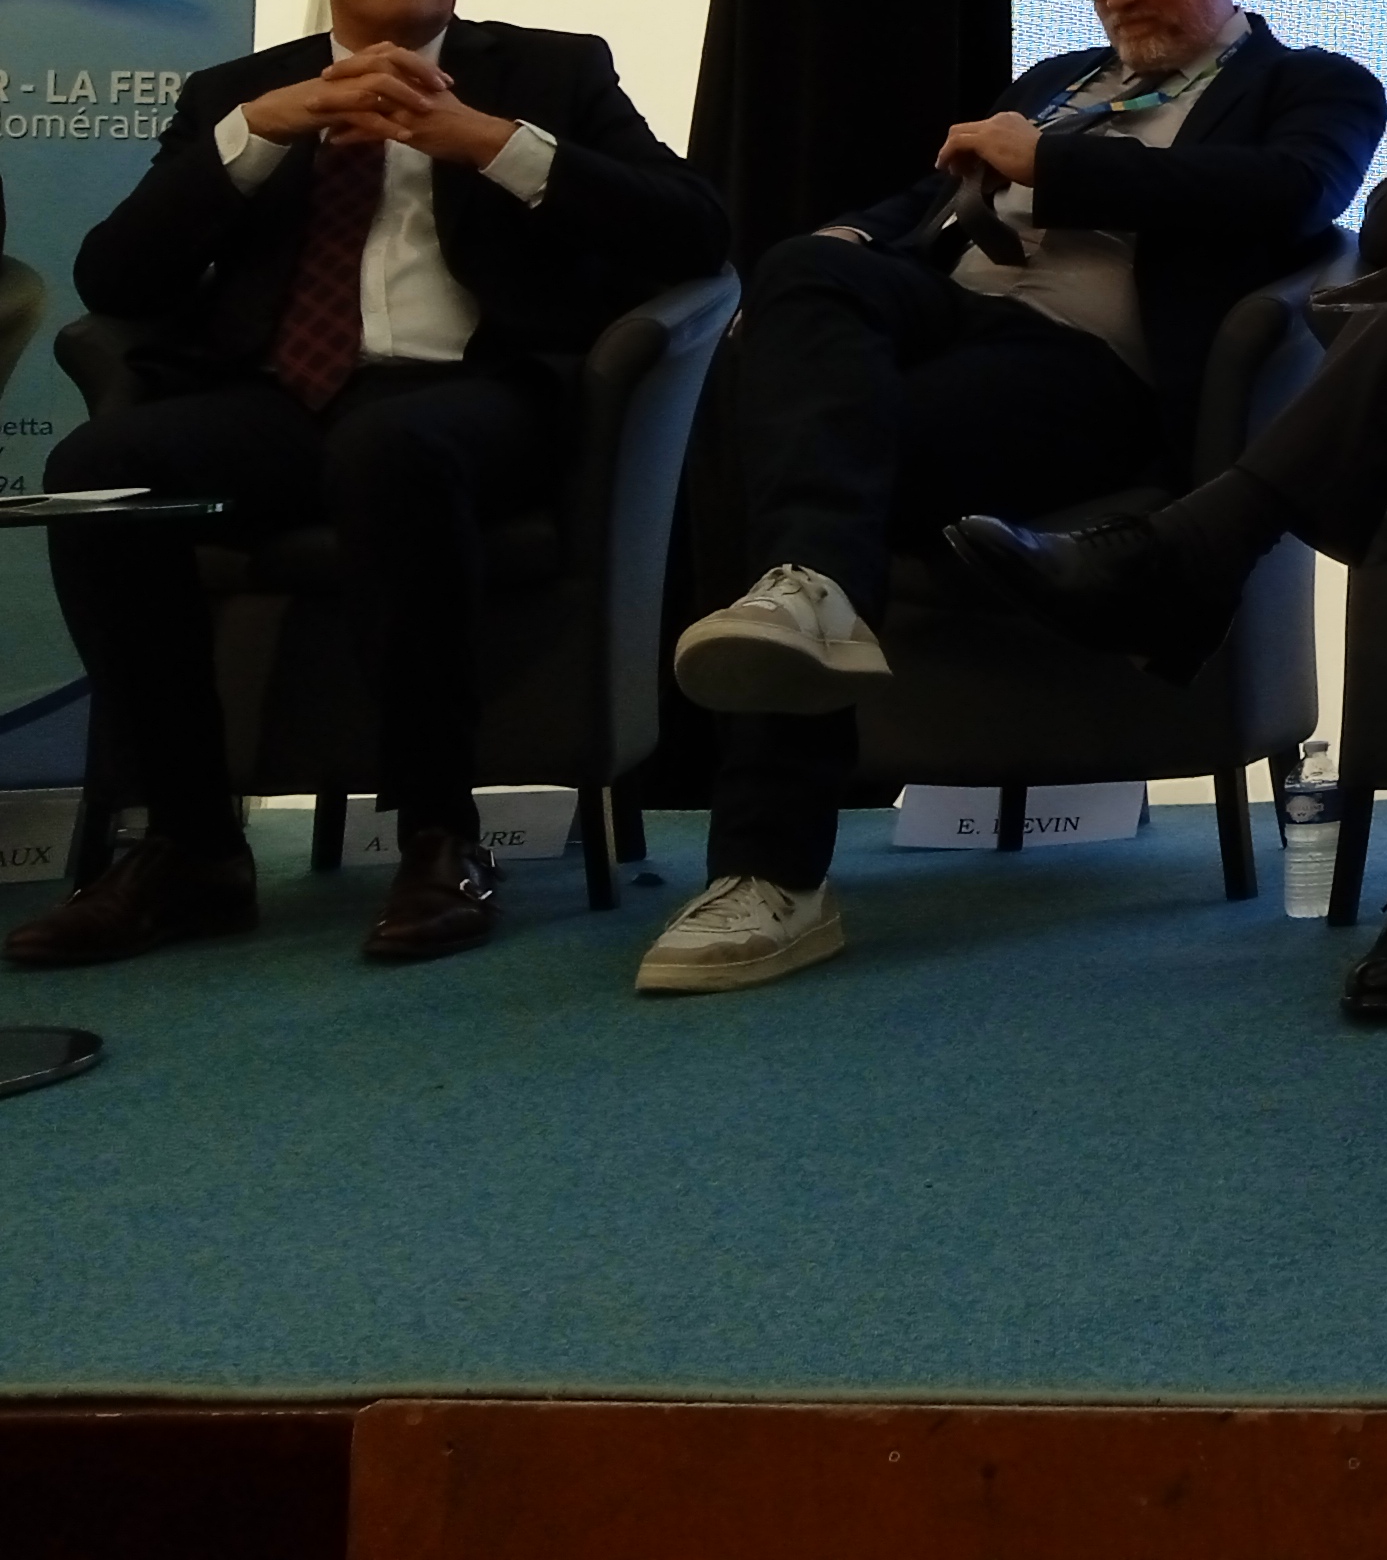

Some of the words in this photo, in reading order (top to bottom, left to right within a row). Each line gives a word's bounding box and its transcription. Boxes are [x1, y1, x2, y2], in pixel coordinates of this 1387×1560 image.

[47, 70, 98, 104] LA
[110, 70, 193, 104] FER
[0, 106, 174, 139] omérati
[0, 418, 53, 436] etta
[957, 818, 981, 835] E.
[364, 836, 389, 852] A.
